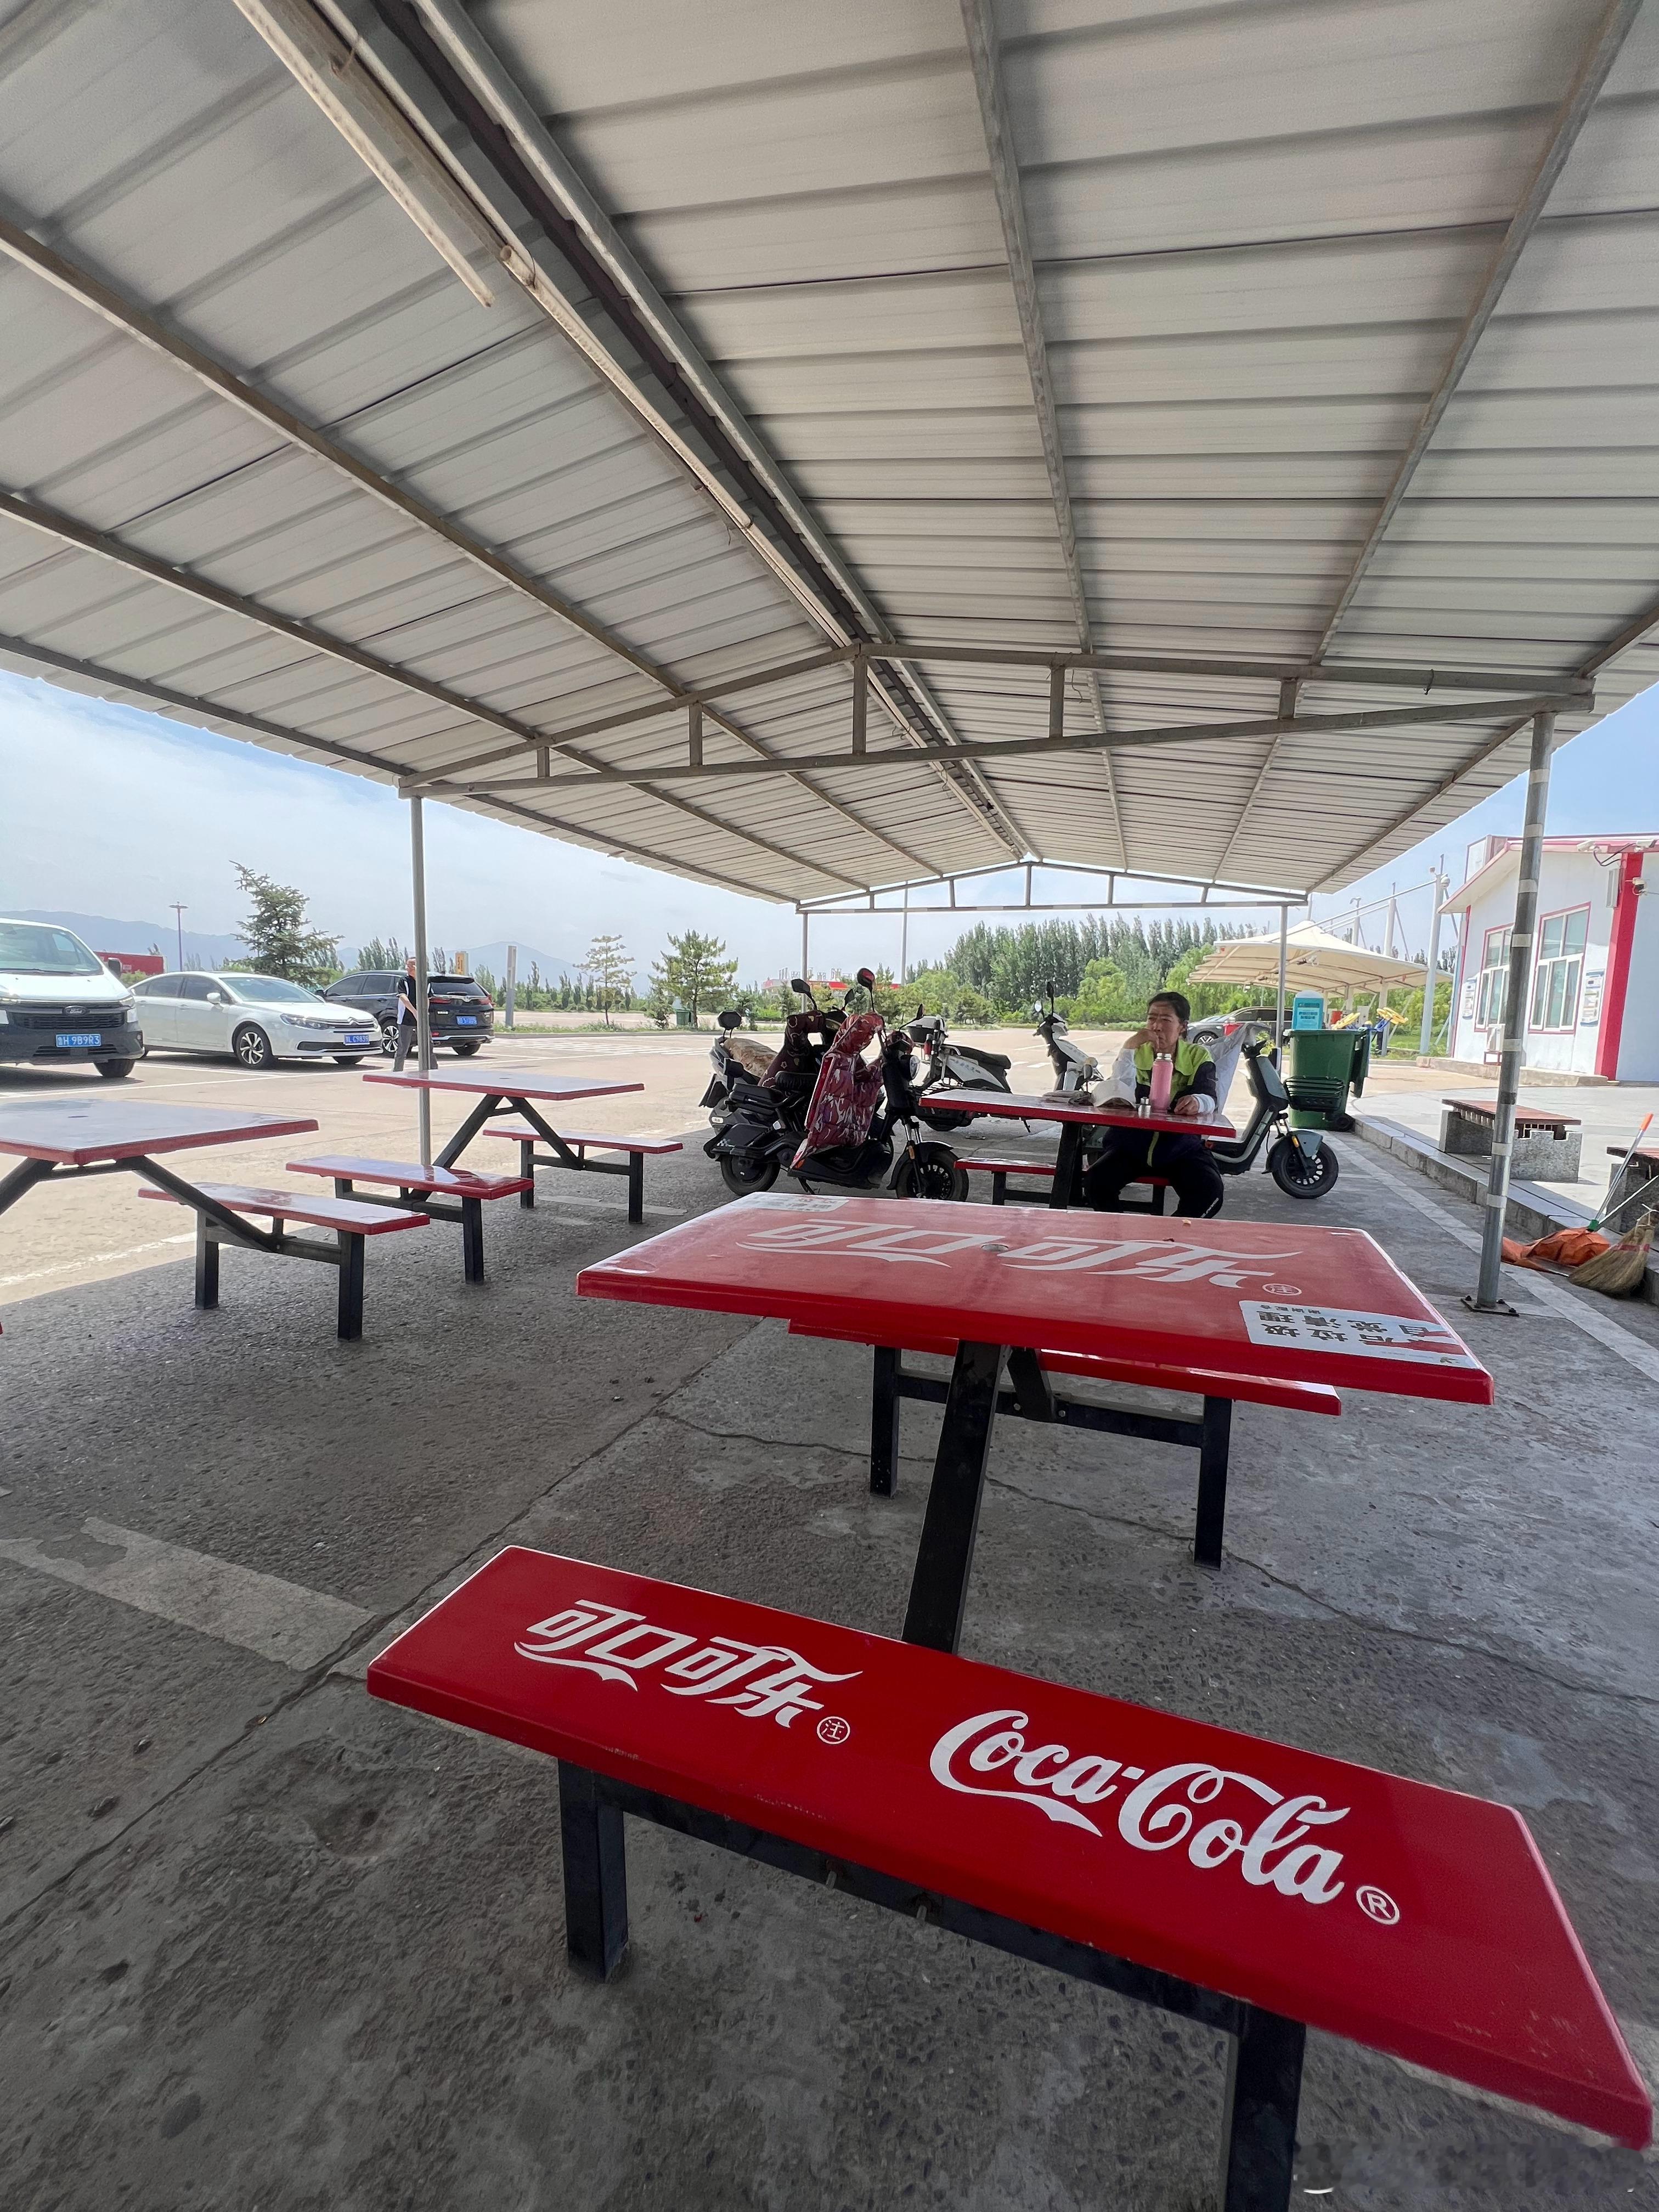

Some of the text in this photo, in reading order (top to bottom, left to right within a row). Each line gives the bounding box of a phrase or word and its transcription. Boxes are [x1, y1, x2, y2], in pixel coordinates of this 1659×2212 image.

[736, 1218, 1303, 1288] 可口可乐
[1261, 1324, 1422, 1344] 后垃圾
[514, 1599, 863, 1728] 可口可乐
[930, 1709, 1351, 1904] Coca-Cola
